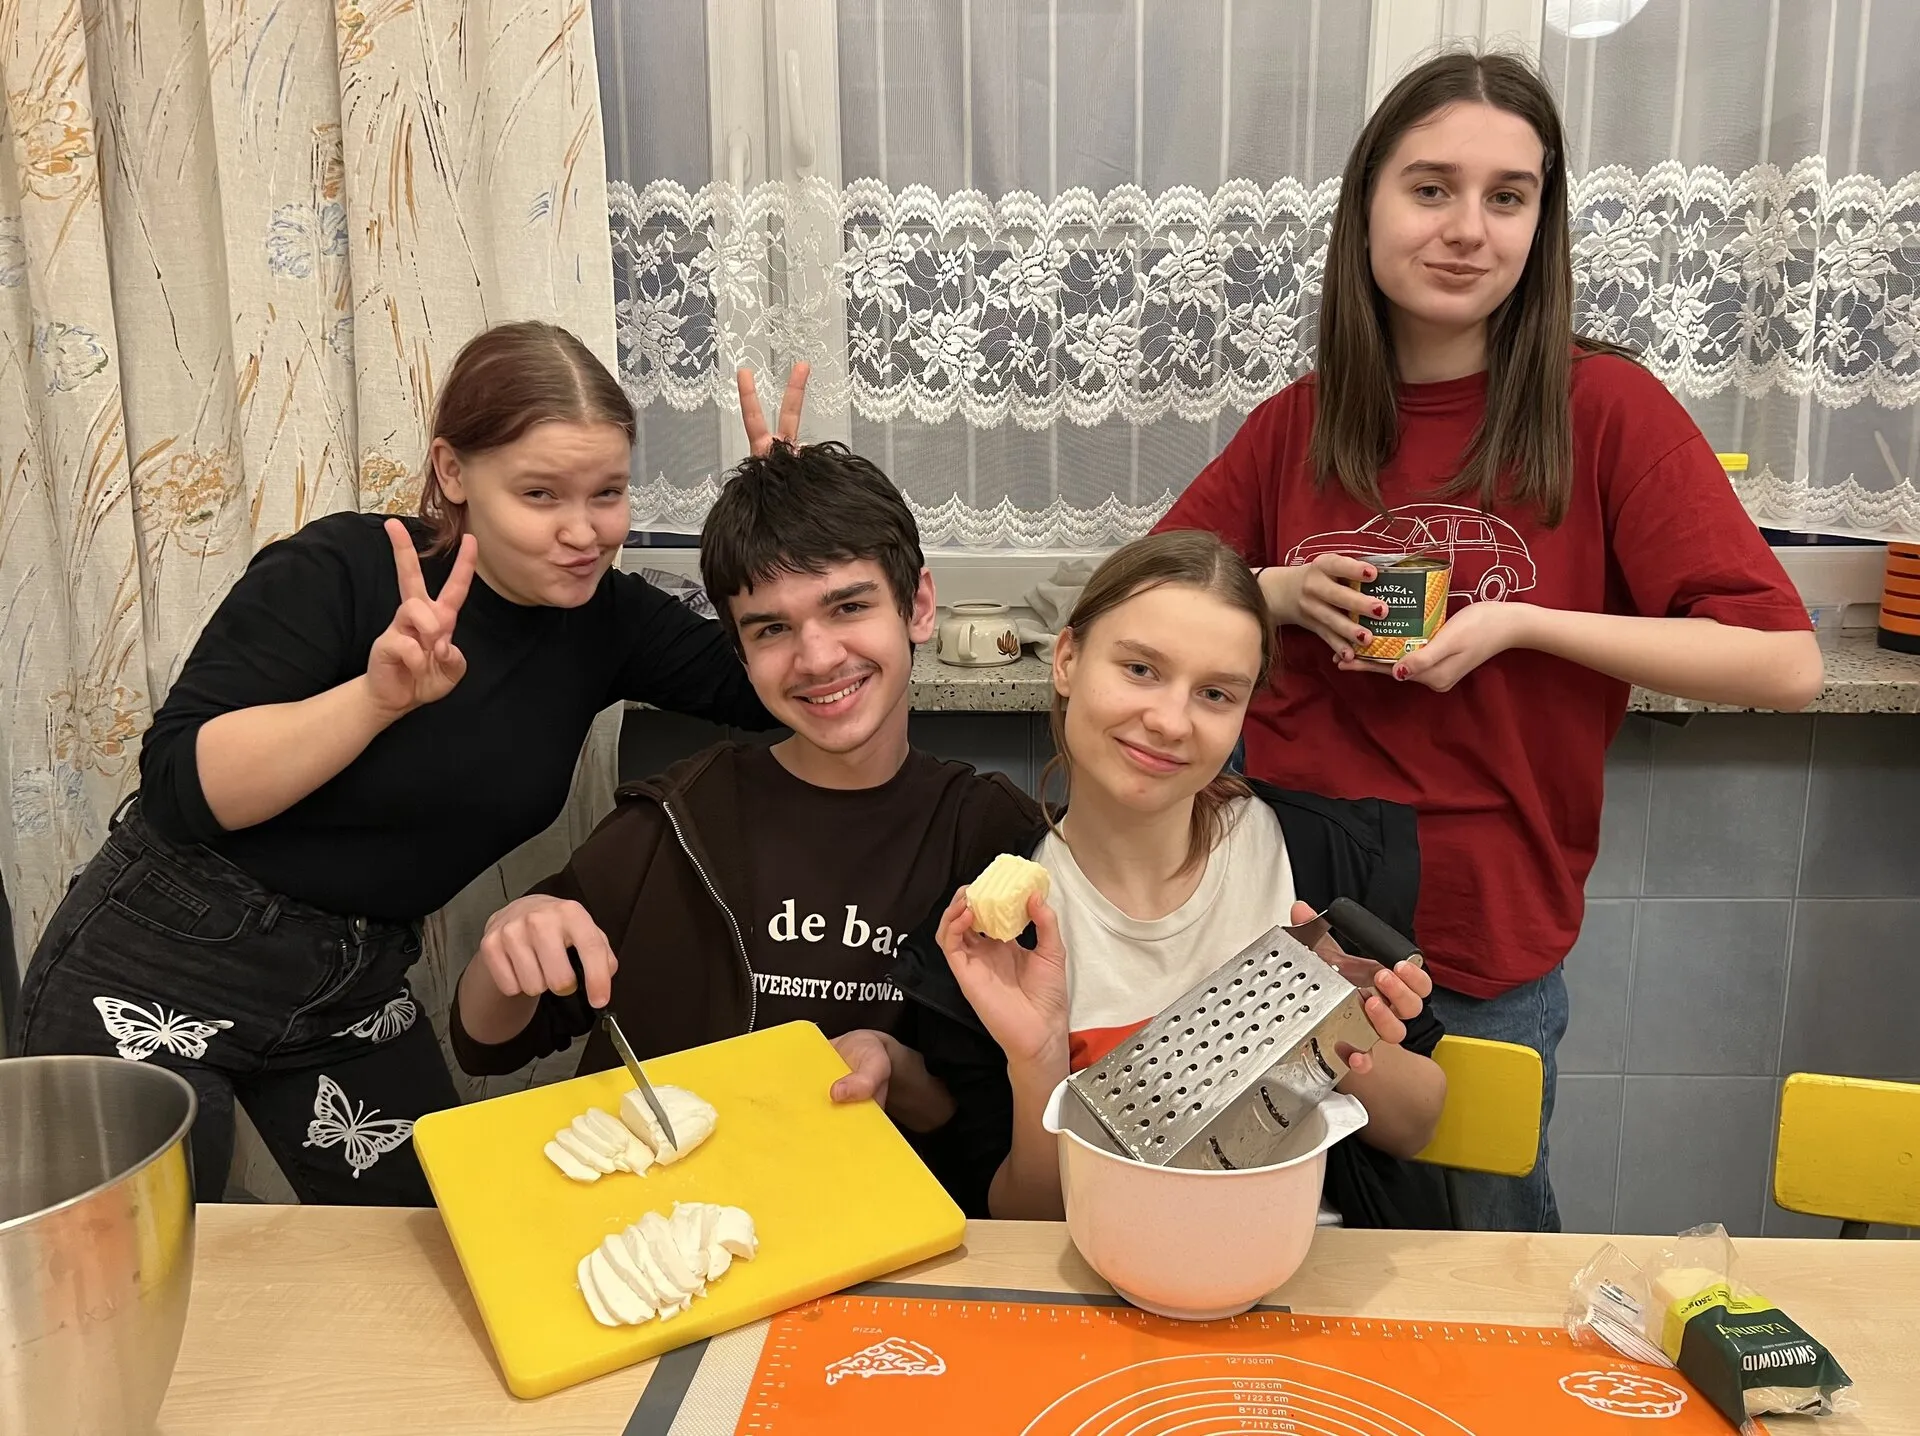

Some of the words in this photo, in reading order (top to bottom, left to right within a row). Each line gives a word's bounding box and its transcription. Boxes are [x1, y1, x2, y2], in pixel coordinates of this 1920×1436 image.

[1375, 584, 1407, 595] NASZA
[768, 898, 826, 942] de
[833, 981, 857, 1000] OF
[858, 982, 903, 1001] IOWA
[852, 1326, 883, 1334] PIZZA
[1742, 1344, 1817, 1371] ŚWIATOWID
